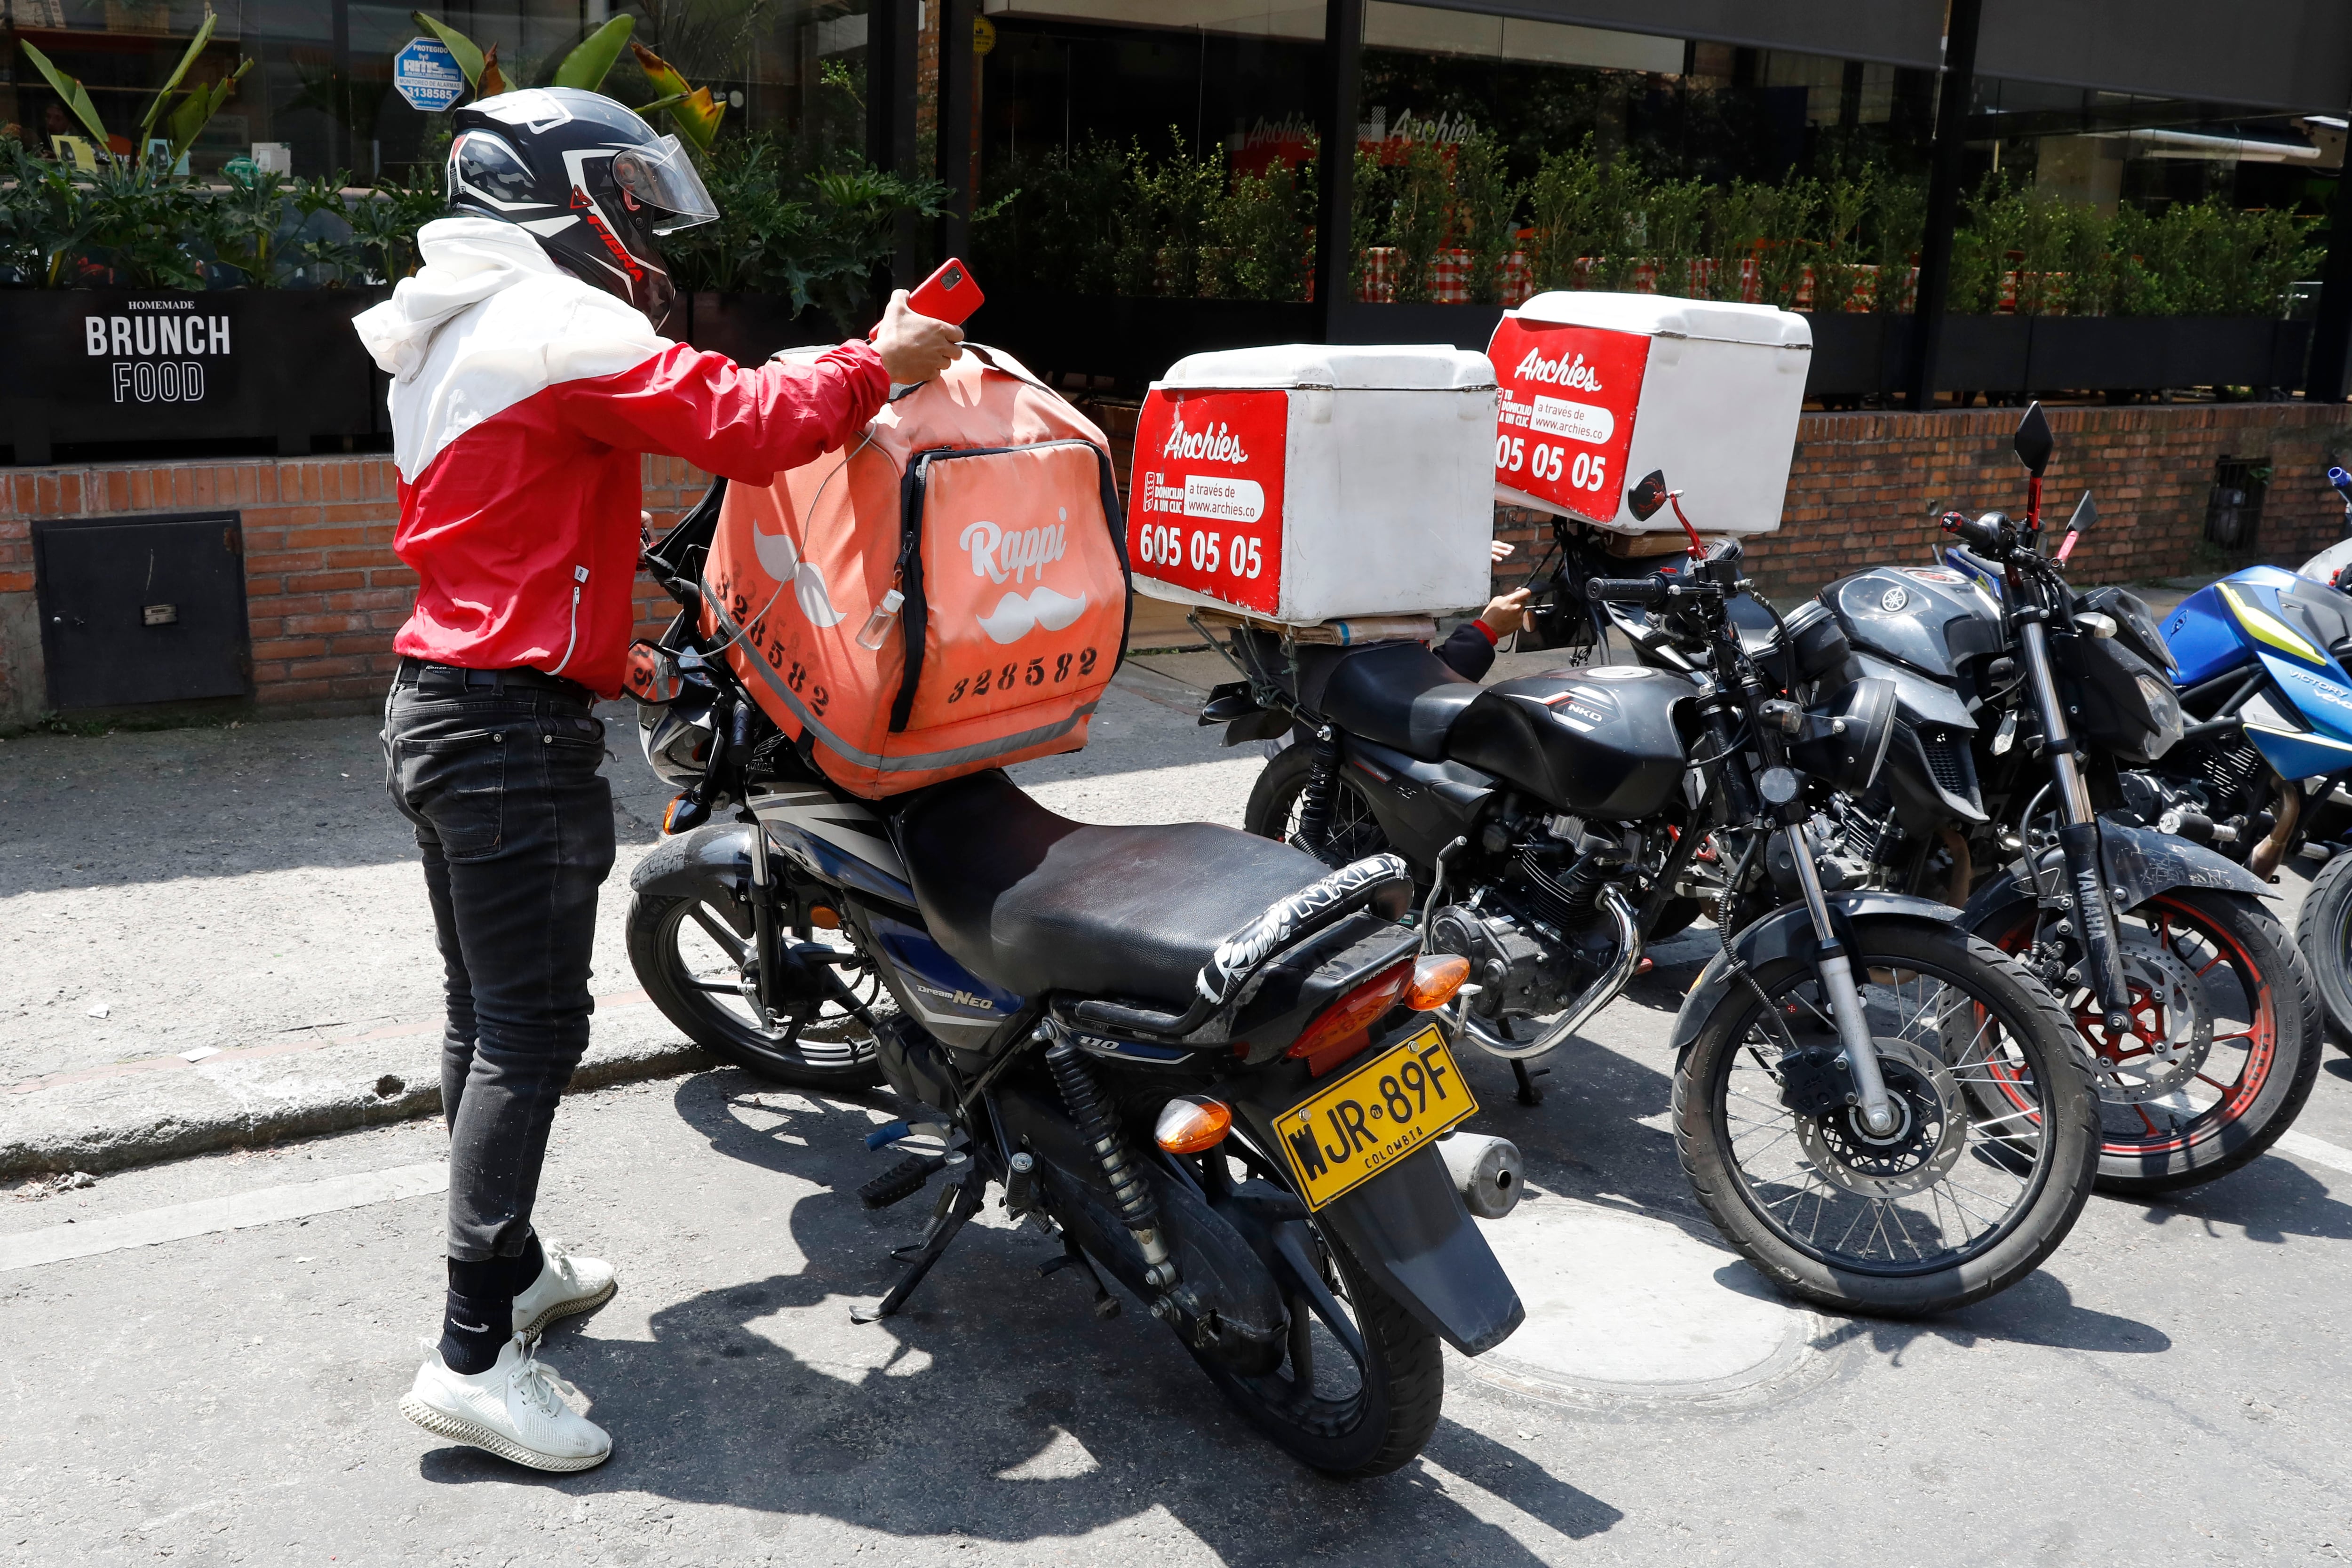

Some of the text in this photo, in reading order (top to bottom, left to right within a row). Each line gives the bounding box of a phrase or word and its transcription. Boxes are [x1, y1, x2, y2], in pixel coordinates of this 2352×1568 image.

[413, 44, 448, 54] PROTEGIDO
[407, 87, 452, 99] 3138585
[586, 215, 644, 283] FIBRA
[128, 301, 195, 310] HOMEMADE
[85, 316, 230, 356] BRUNCH
[1514, 347, 1602, 392] Archies
[113, 361, 204, 402] FOOD
[1504, 390, 1514, 400] TU
[1502, 401, 1533, 416] DOMICILIO
[1538, 402, 1585, 421] a través de
[1499, 412, 1529, 428] A UN CLIC
[1536, 418, 1603, 439] www.archies.co
[1164, 420, 1248, 464] Archies
[1496, 434, 1606, 492] 05 05 05
[1155, 472, 1164, 485] TU
[1154, 486, 1184, 500] DOMICILIO
[1189, 482, 1235, 498] a través de
[1153, 500, 1182, 514] A UN CLIC
[1189, 501, 1255, 517] www.archies.co
[959, 506, 1067, 585] Rappi
[1140, 524, 1262, 579] 605 05 05
[715, 572, 829, 717] 328582
[947, 646, 1097, 704] 328582
[2289, 669, 2349, 698] VICTORY
[2313, 688, 2352, 710] VENO
[1567, 704, 1603, 722] NKD
[2076, 868, 2107, 940] YAMAHA
[916, 984, 954, 999] Dream
[1079, 1035, 1120, 1051] 110
[1364, 1126, 1424, 1169] COLOMBIA
